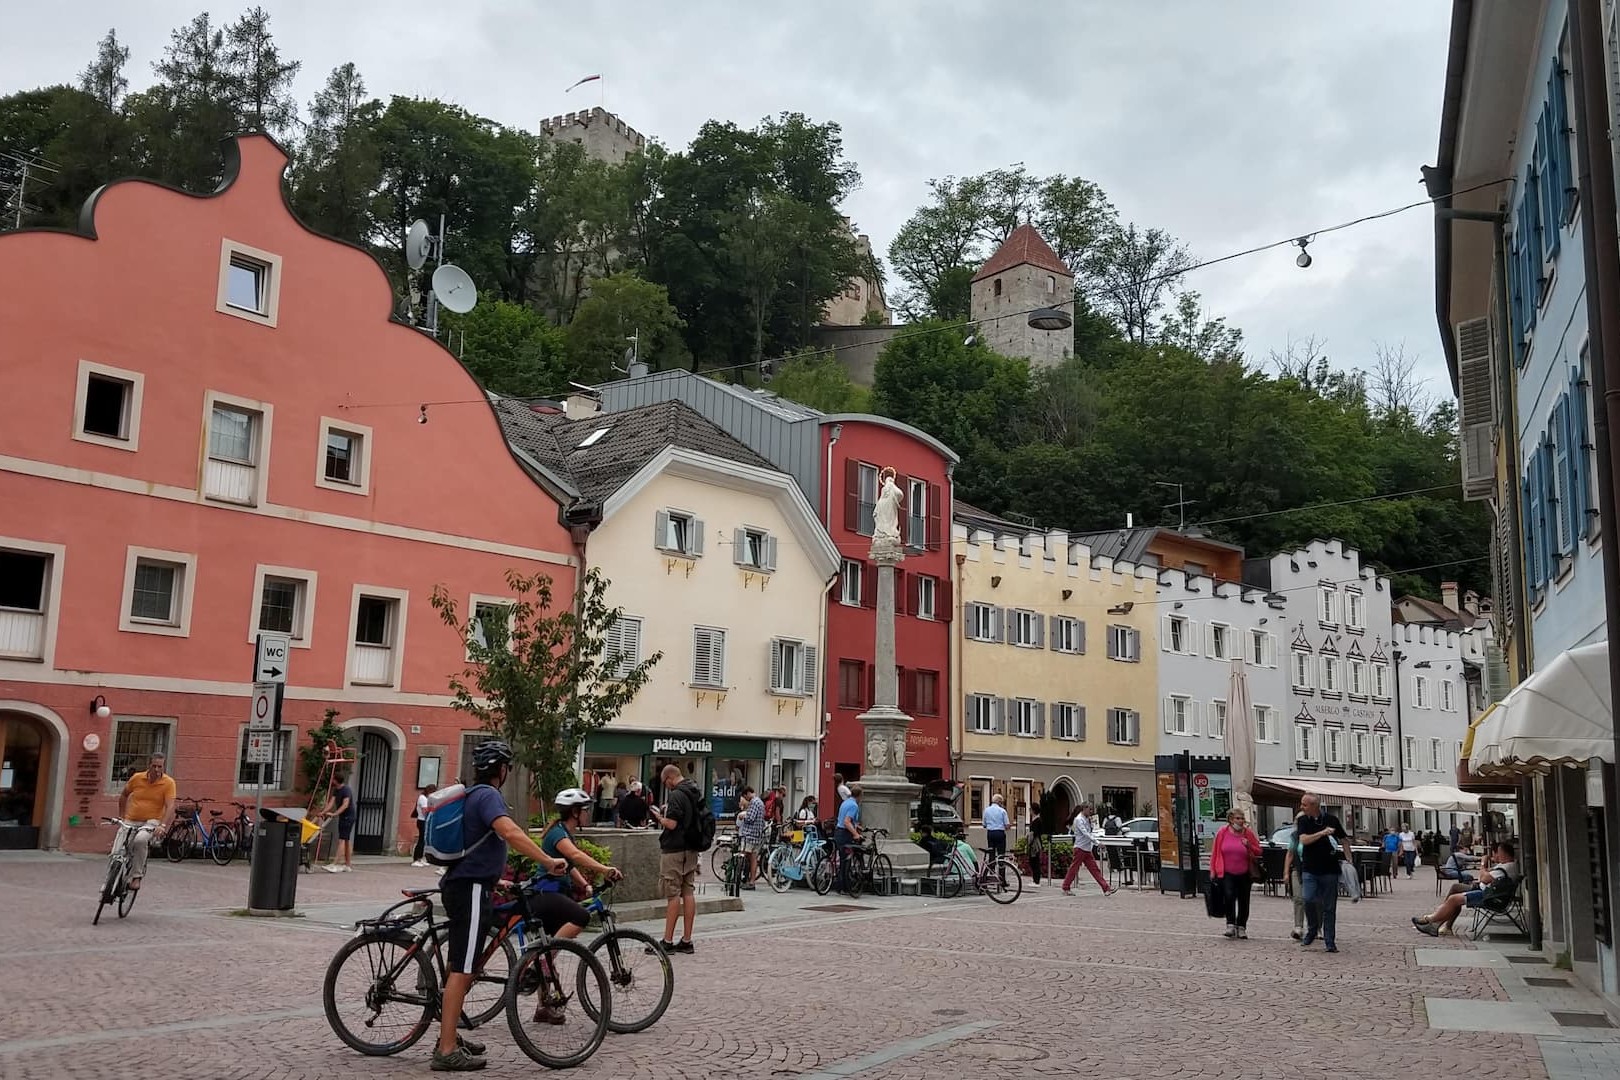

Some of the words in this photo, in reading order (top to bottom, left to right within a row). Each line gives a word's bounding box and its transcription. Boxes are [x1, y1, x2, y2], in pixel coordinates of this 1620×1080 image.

[266, 647, 283, 658] WC
[652, 738, 713, 754] patagonia
[712, 785, 737, 797] Saldi
